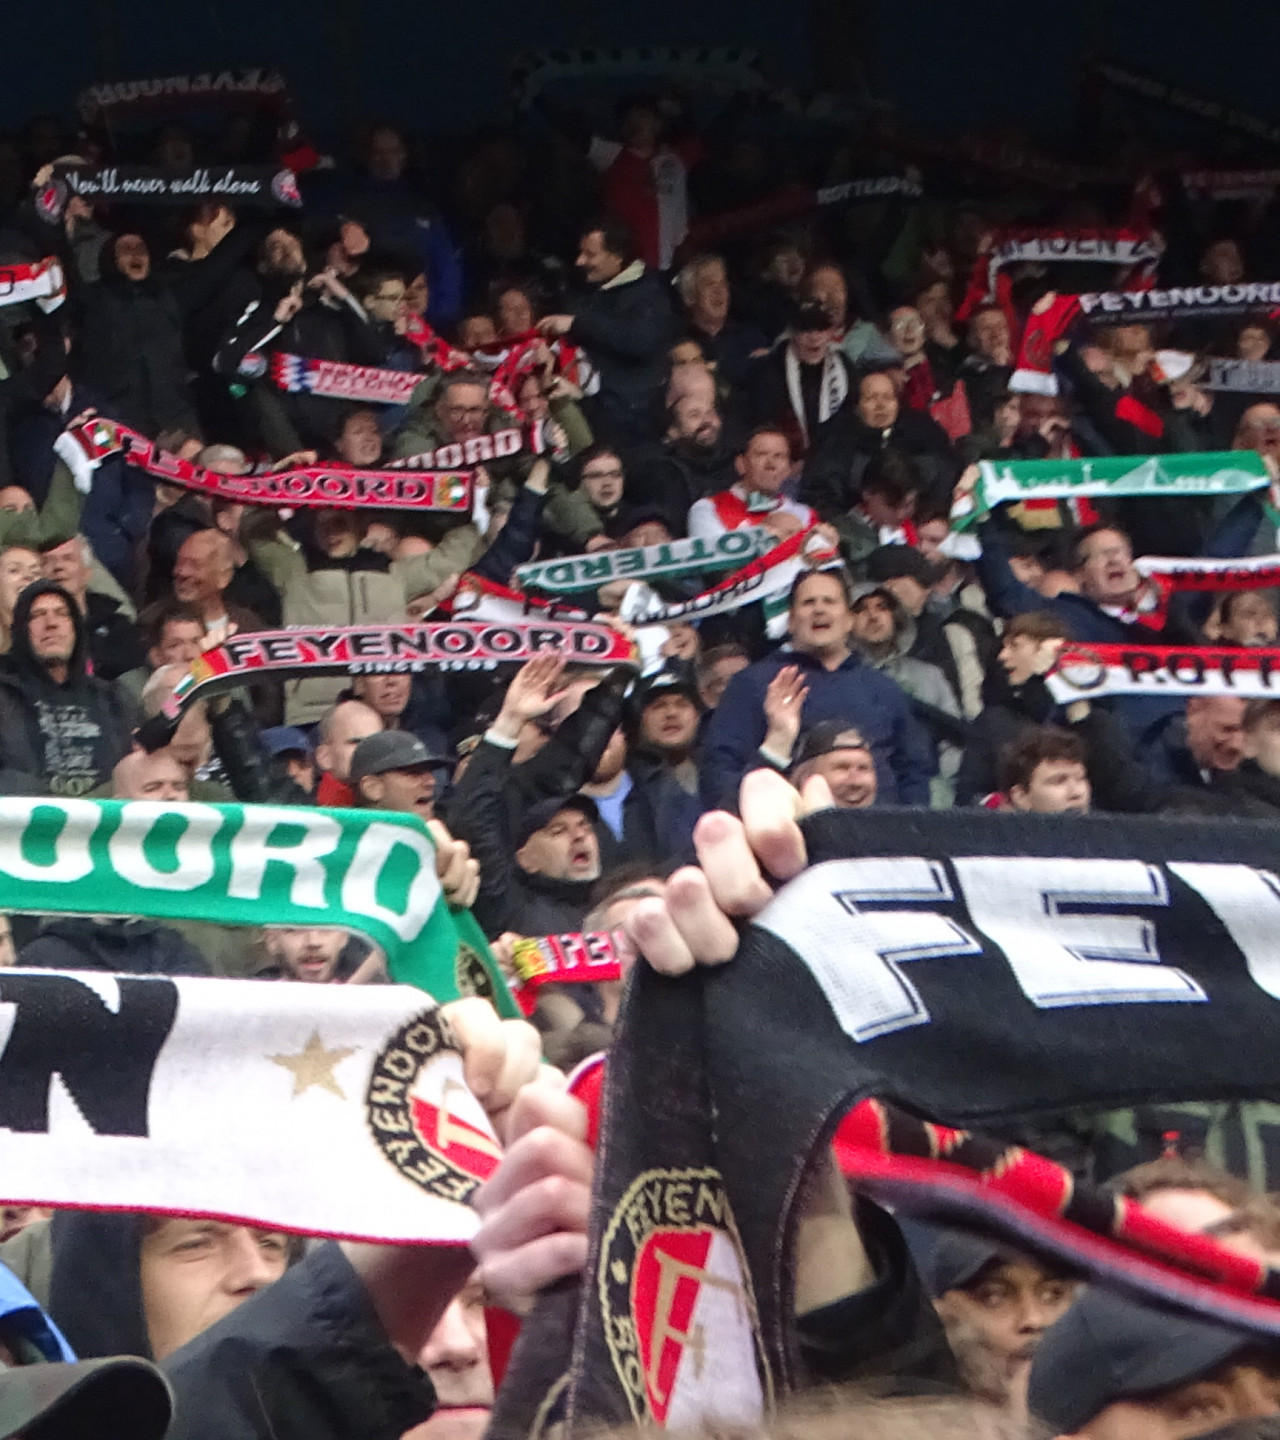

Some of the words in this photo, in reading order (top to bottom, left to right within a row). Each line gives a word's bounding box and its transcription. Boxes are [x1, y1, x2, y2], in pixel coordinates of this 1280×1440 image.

[121, 177, 166, 195] never
[170, 168, 211, 195] walk
[213, 168, 261, 195] alone
[1078, 282, 1280, 314] FEYENOOR
[224, 628, 610, 667] FEYENOORD
[370, 1013, 478, 1201] FEYENOO
